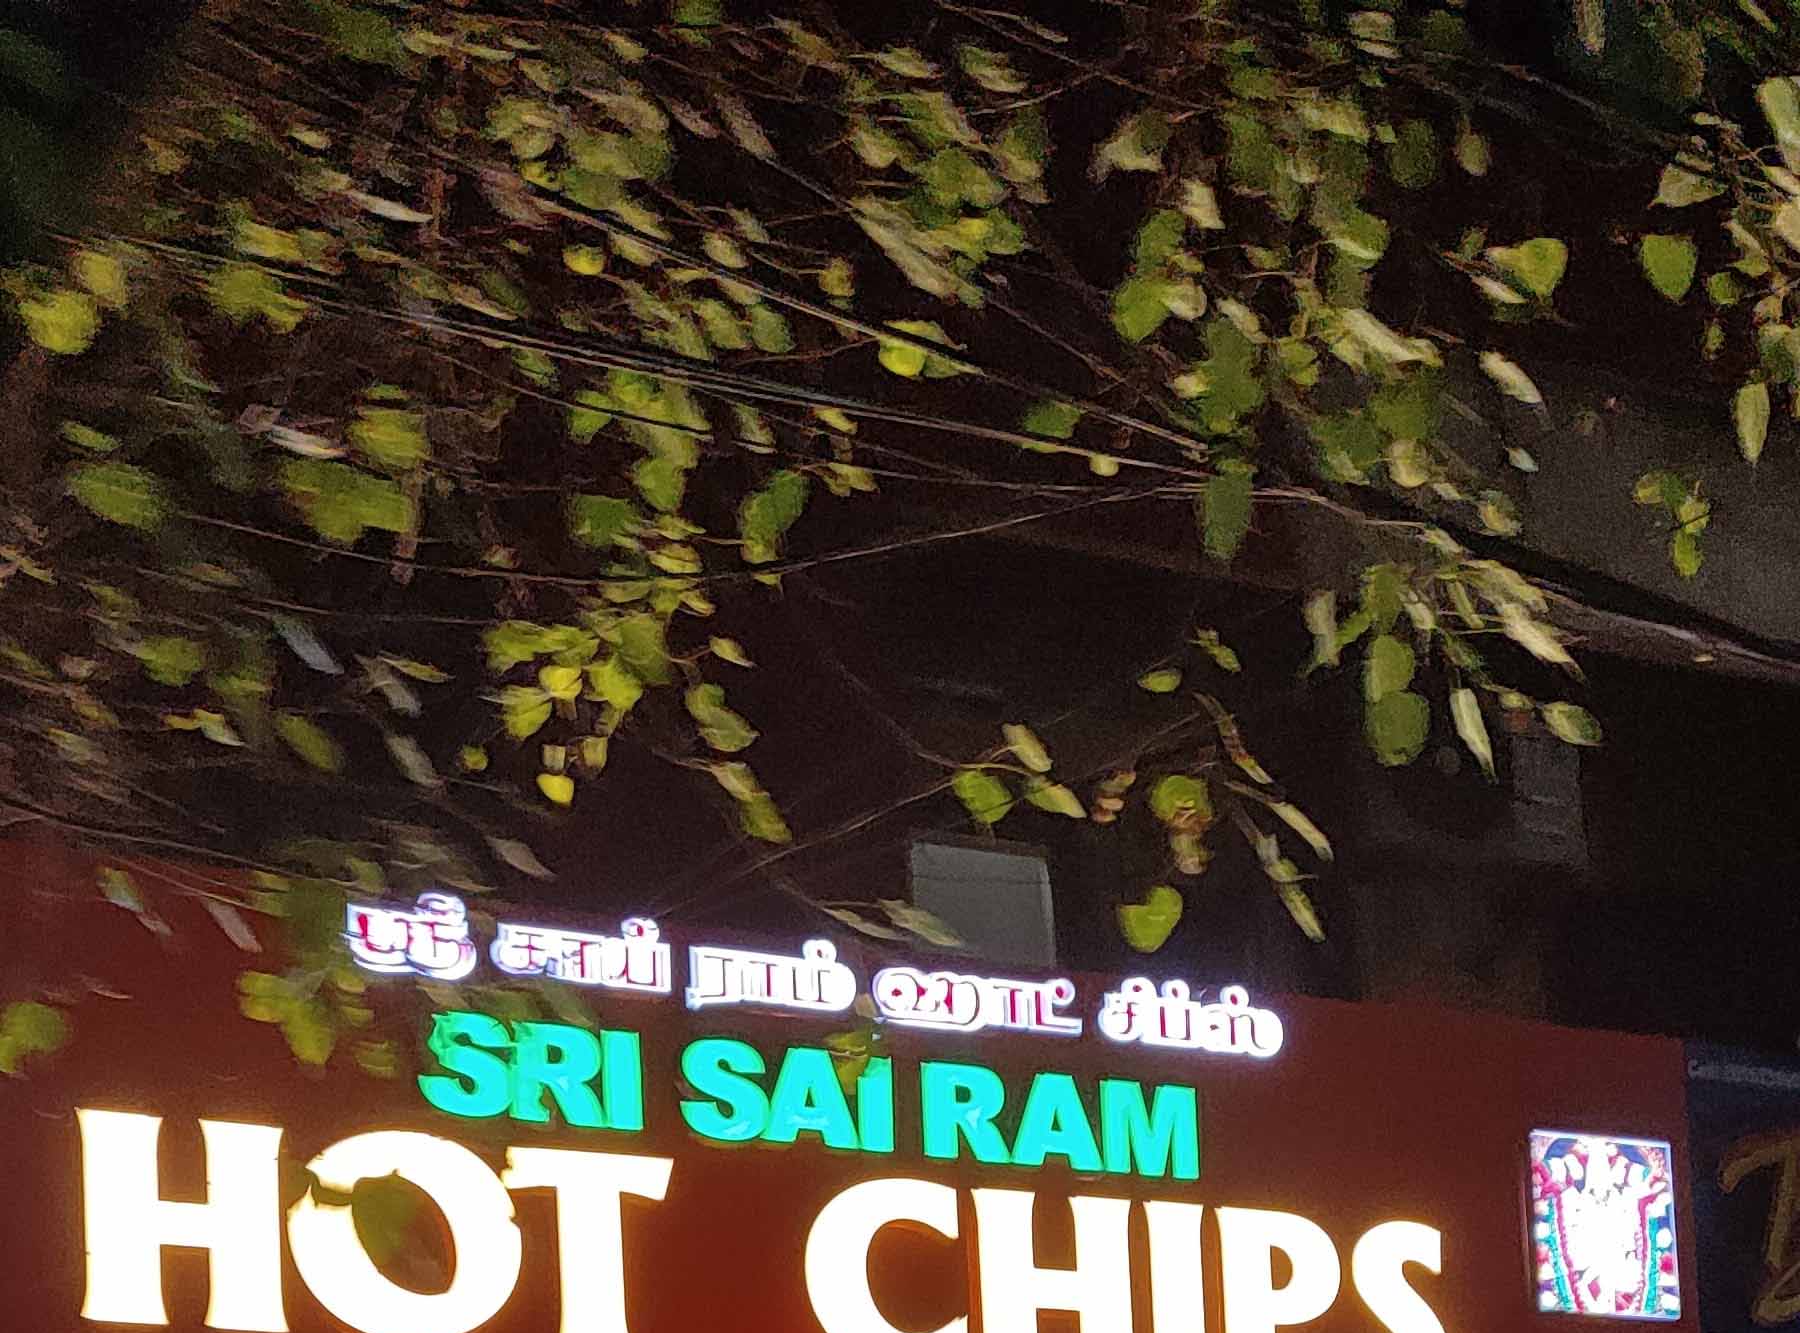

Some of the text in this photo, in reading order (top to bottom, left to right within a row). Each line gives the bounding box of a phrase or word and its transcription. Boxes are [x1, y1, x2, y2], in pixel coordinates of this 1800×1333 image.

[491, 918, 672, 993] சாய்
[686, 940, 857, 1012] ராம்
[873, 966, 1083, 1036] ஹாட்
[1098, 977, 1285, 1058] சிப்ஸ்
[418, 1012, 1200, 1180] SRI SAI RAM
